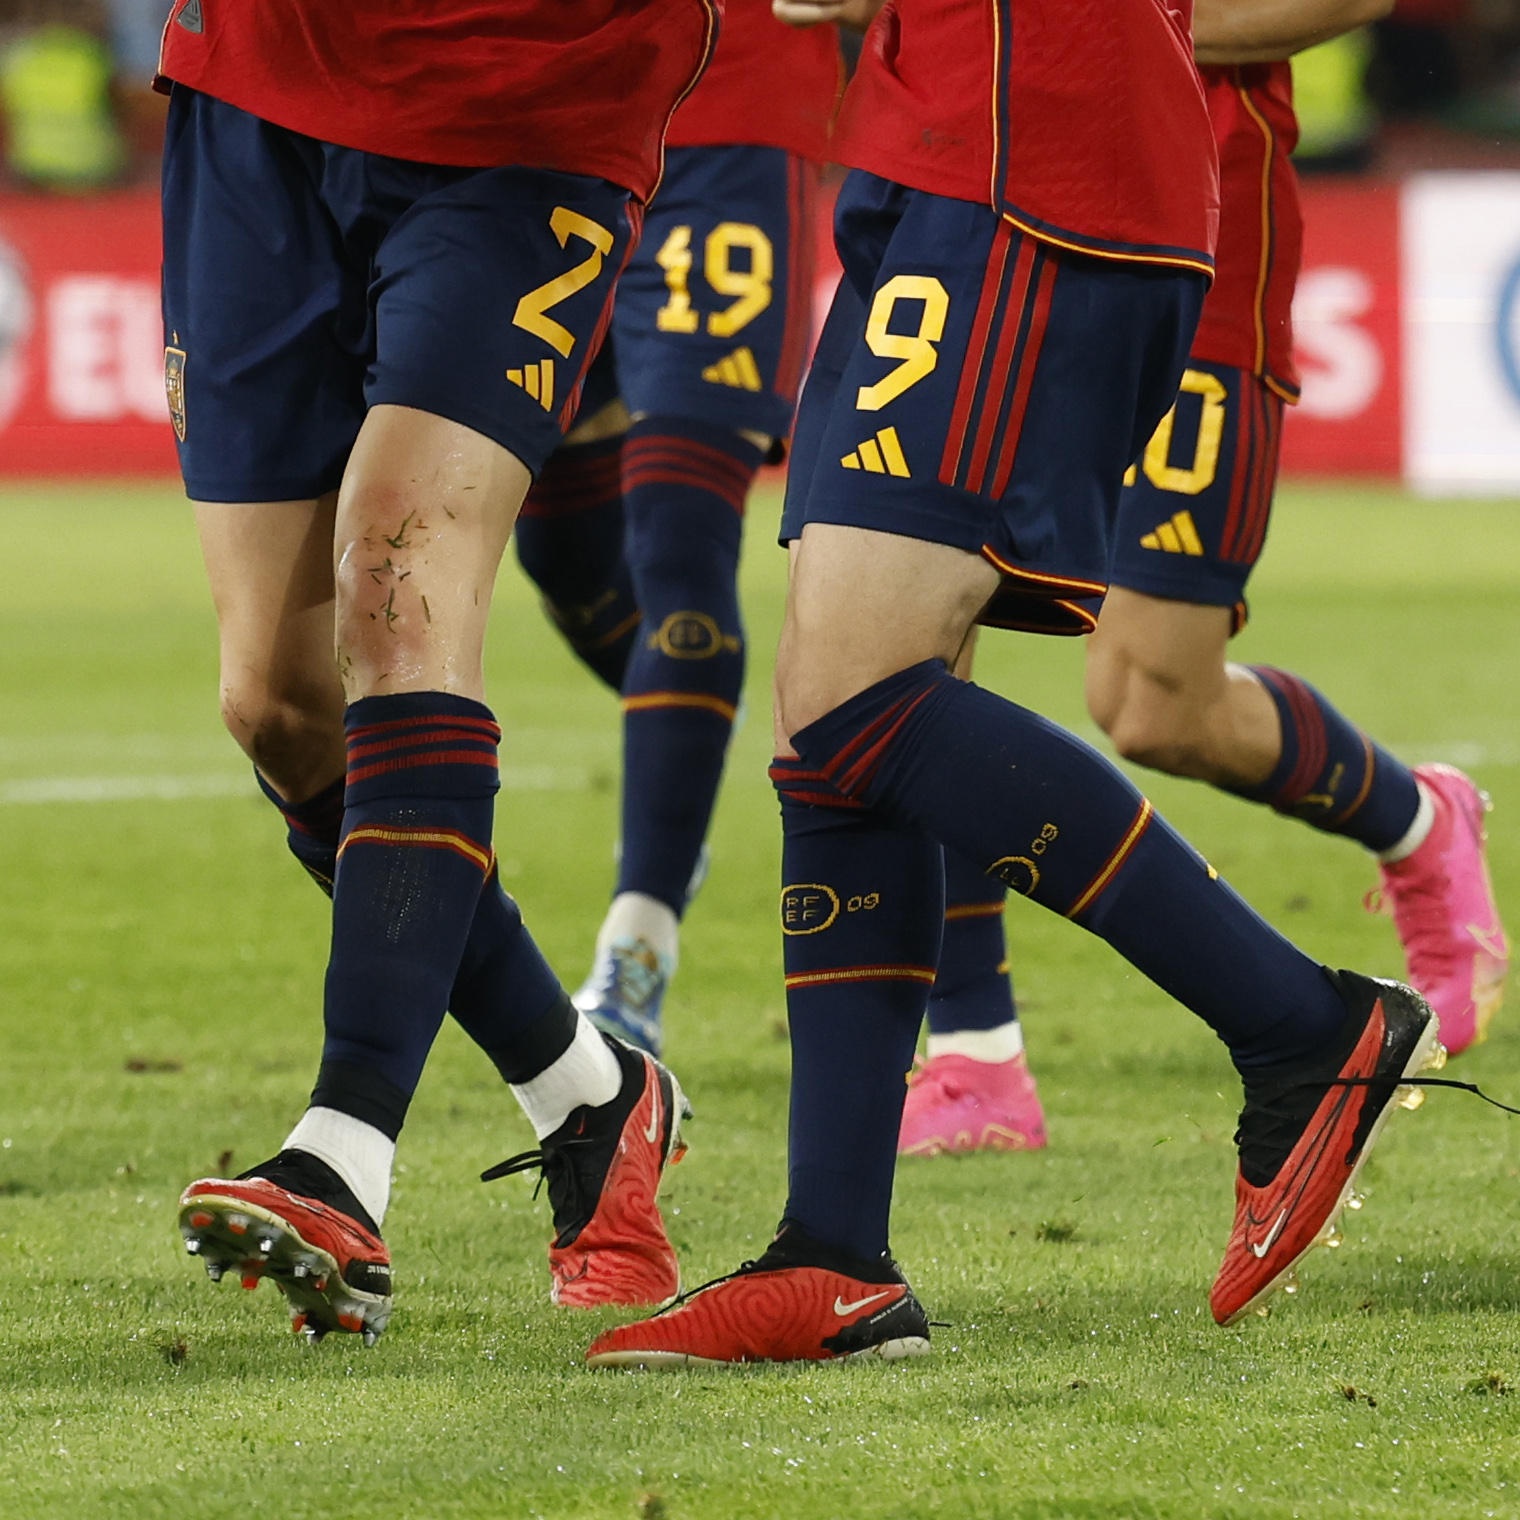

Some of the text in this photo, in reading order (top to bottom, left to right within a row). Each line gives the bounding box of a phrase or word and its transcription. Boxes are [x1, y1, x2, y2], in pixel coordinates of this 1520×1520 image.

[512, 206, 615, 359] 2
[656, 221, 774, 337] 19
[855, 274, 950, 411] 9
[1122, 367, 1229, 495] 0
[846, 891, 880, 912] 09
